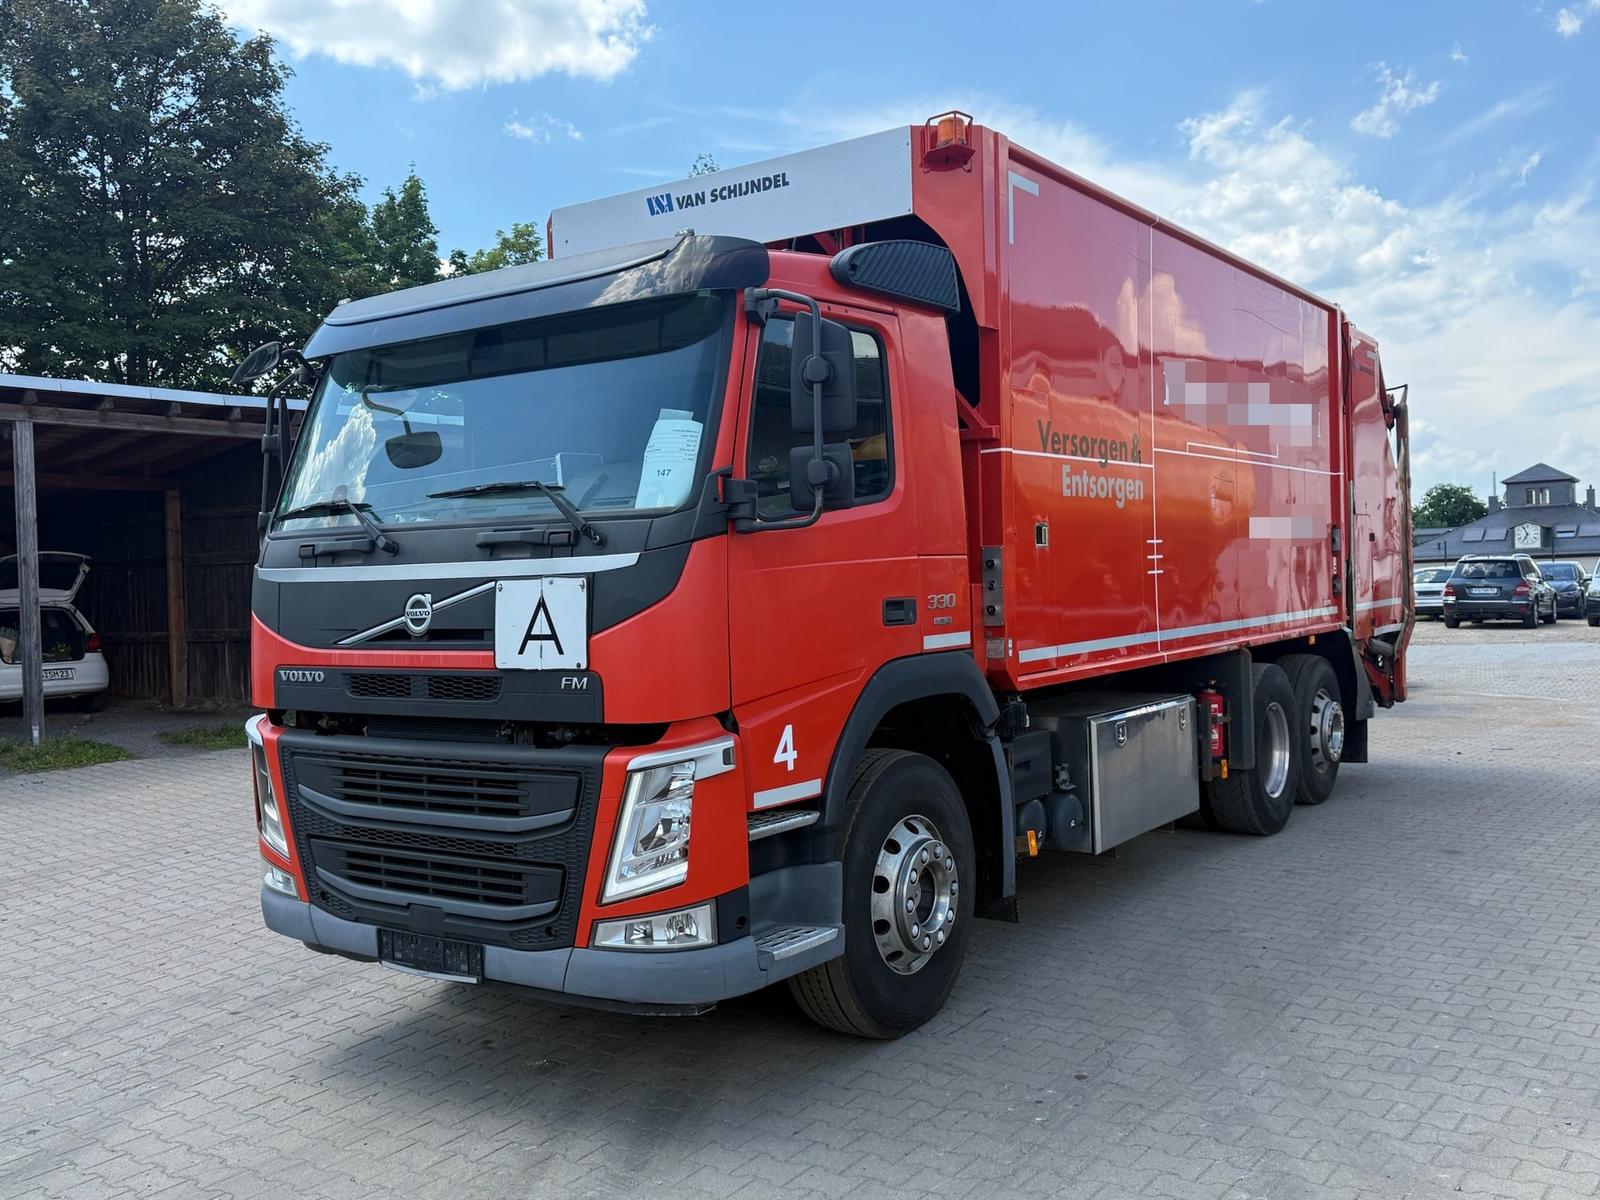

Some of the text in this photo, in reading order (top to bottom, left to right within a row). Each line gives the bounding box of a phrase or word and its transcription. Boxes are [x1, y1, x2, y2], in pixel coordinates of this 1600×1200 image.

[675, 191, 706, 210] VAN
[710, 172, 790, 203] SCHIJNDEL
[1037, 418, 1142, 470] Versorgen &
[656, 468, 671, 477] 147
[1062, 464, 1144, 509] Entsorgen
[927, 593, 956, 609] 330
[517, 592, 564, 655] A
[278, 670, 325, 682] VOLVO
[560, 677, 588, 690] FM
[773, 724, 798, 771] 4
